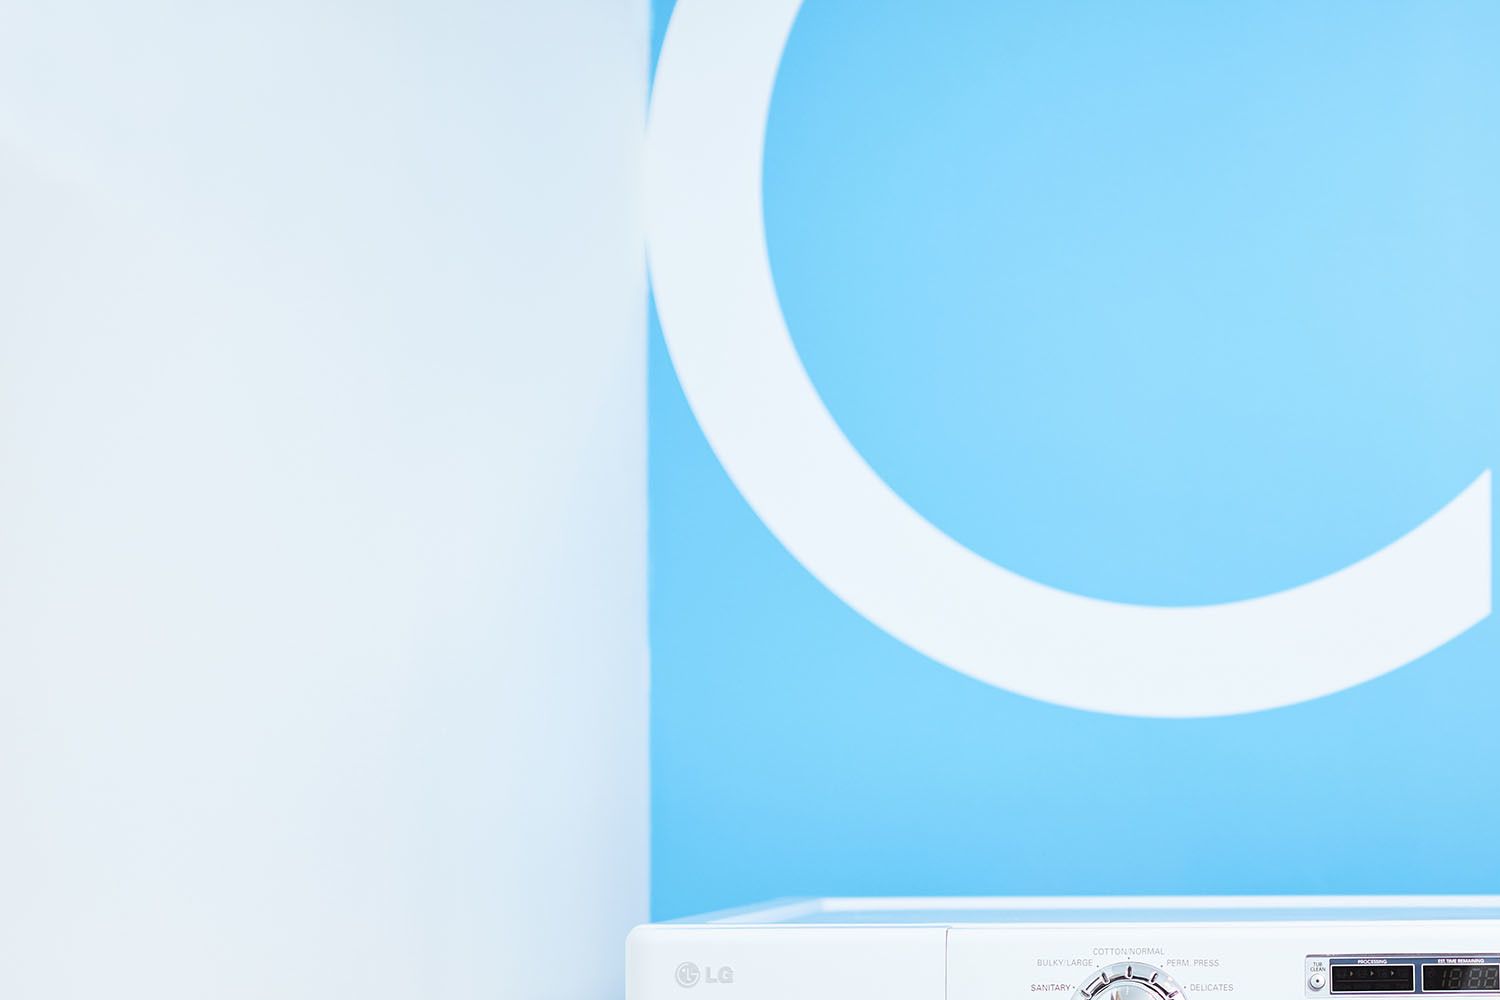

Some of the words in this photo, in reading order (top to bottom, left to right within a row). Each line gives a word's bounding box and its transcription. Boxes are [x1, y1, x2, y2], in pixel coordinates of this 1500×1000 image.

[1093, 948, 1165, 956] COTTON/NORMAL
[1037, 959, 1093, 967] BULKY/LARGE
[1194, 959, 1219, 967] PRESS
[705, 967, 734, 984] LG
[1031, 984, 1071, 992] SANITARY
[1190, 984, 1234, 992] DELICATES
